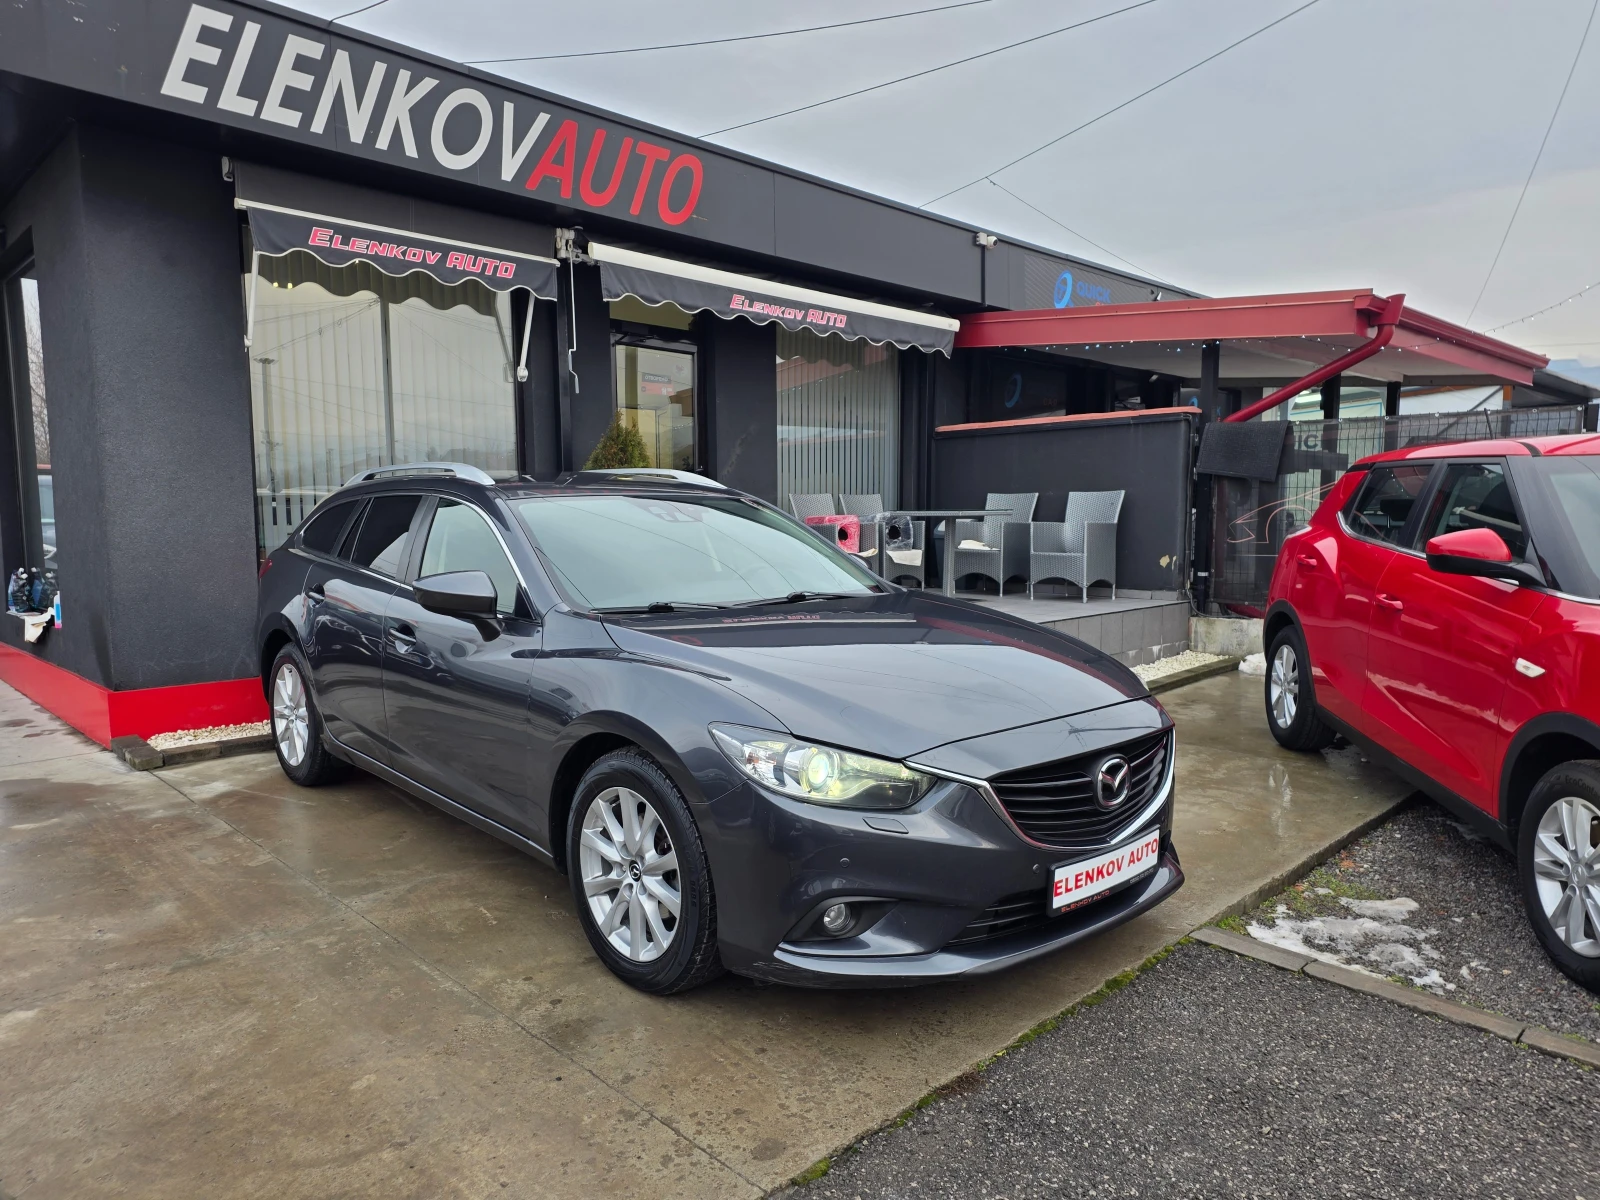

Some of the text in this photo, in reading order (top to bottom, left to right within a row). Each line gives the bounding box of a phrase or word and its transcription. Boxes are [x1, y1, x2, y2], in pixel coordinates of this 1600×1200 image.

[446, 251, 516, 279] AUTO
[1077, 280, 1111, 304] QUICK
[807, 308, 847, 328] AUTO
[1053, 855, 1125, 897] ELENKOV
[1127, 838, 1159, 867] AUTO
